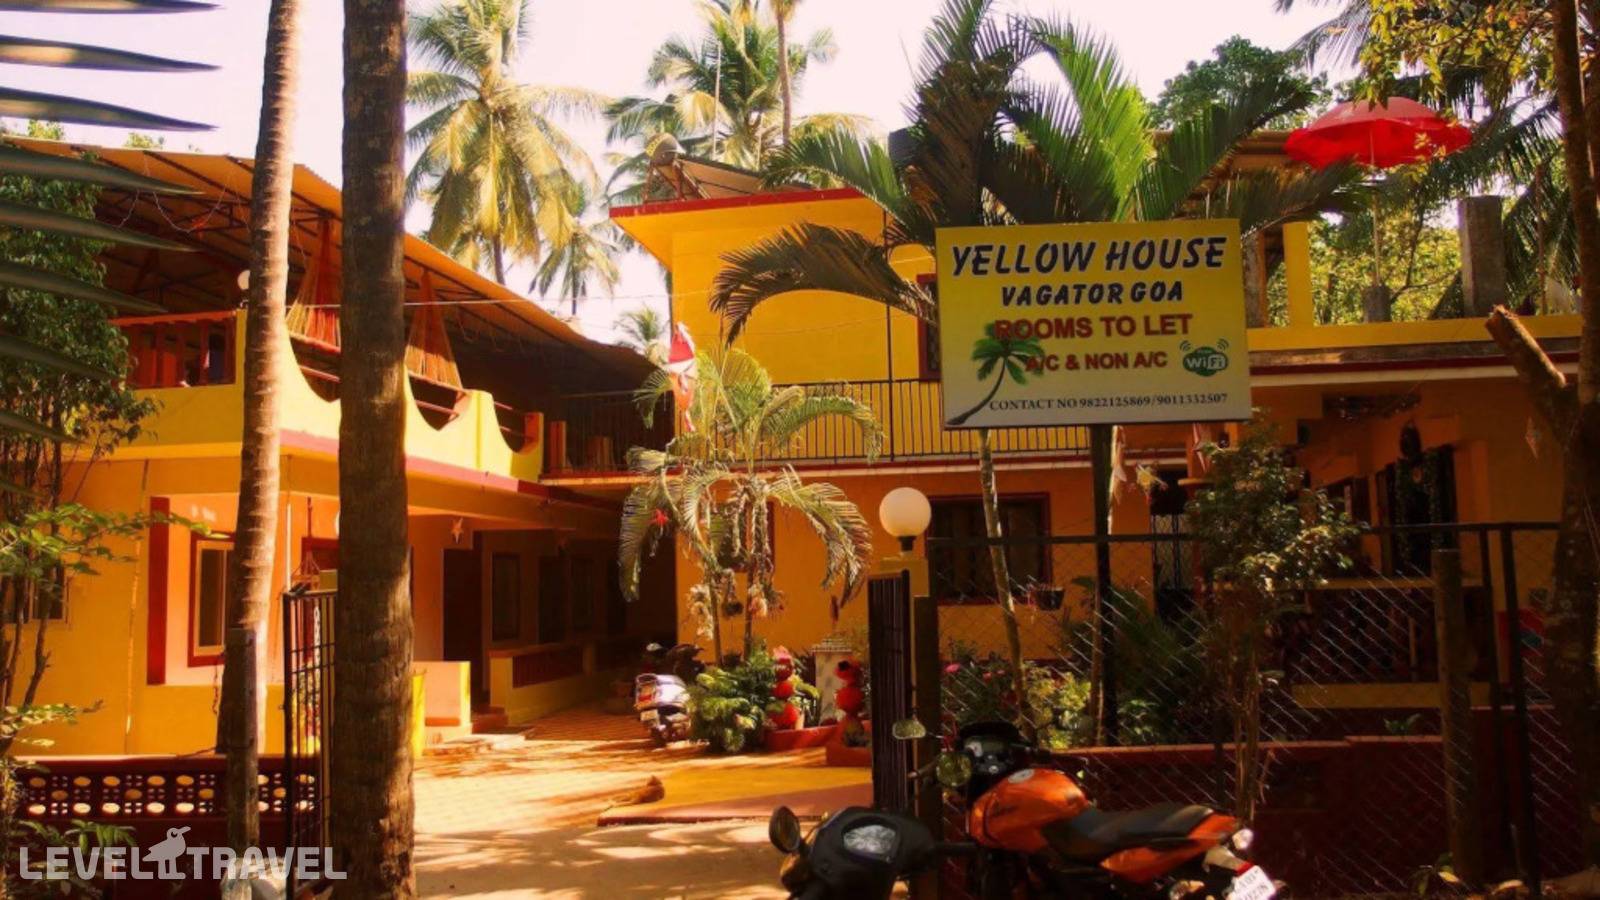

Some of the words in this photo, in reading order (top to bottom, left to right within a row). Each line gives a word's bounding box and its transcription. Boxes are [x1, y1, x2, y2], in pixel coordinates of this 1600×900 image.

[952, 240, 1096, 276] YELLOW
[1105, 236, 1227, 272] HOUSE
[1001, 283, 1123, 307] VAGATOR
[1130, 280, 1183, 303] GOA
[994, 316, 1093, 340] ROOMS
[1100, 315, 1136, 337] TO
[1144, 313, 1193, 336] LET
[1025, 353, 1060, 372] A/C
[1065, 353, 1080, 370] &
[1086, 352, 1129, 370] NON
[1133, 351, 1168, 369] A/C
[990, 399, 1055, 411] CONTACT
[1057, 398, 1078, 409] NO
